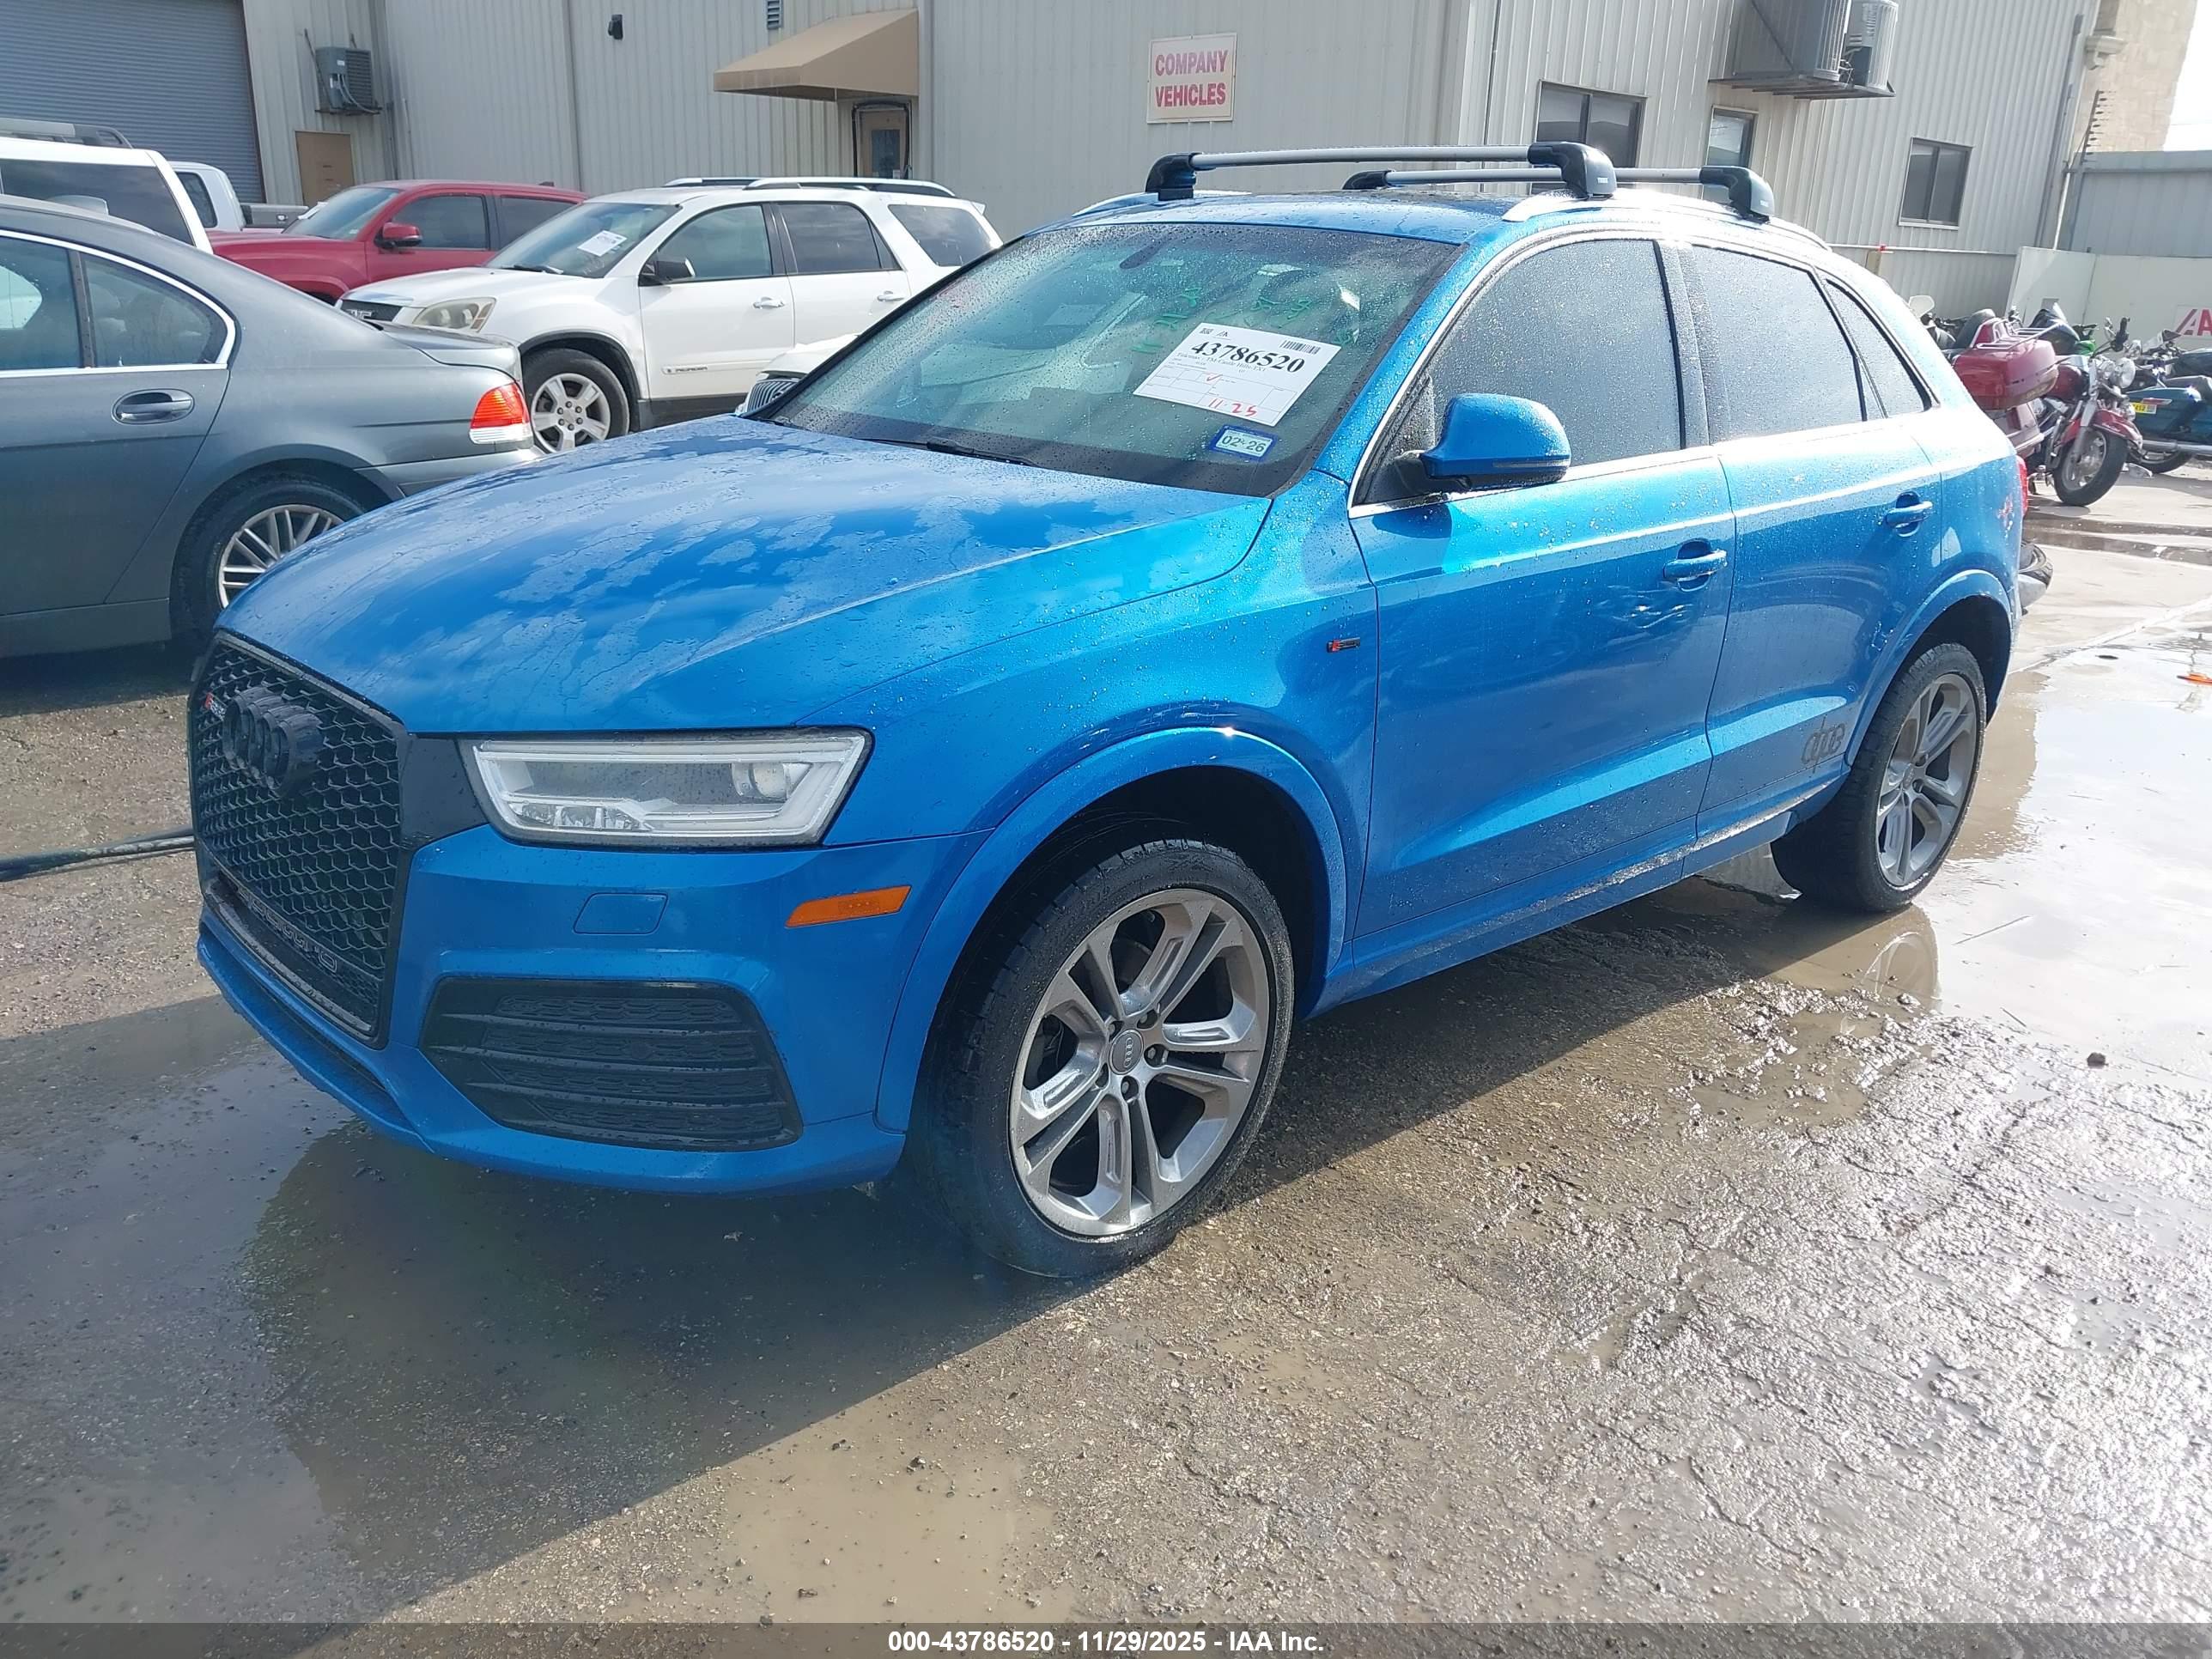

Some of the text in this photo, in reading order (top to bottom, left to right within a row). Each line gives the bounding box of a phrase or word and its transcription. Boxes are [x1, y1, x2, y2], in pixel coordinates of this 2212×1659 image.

[1155, 50, 1228, 76] COMPANY
[1155, 82, 1226, 107] VEHICLES
[1191, 341, 1305, 373] 43786520
[1221, 435, 1243, 447] 02
[1246, 441, 1267, 453] 26
